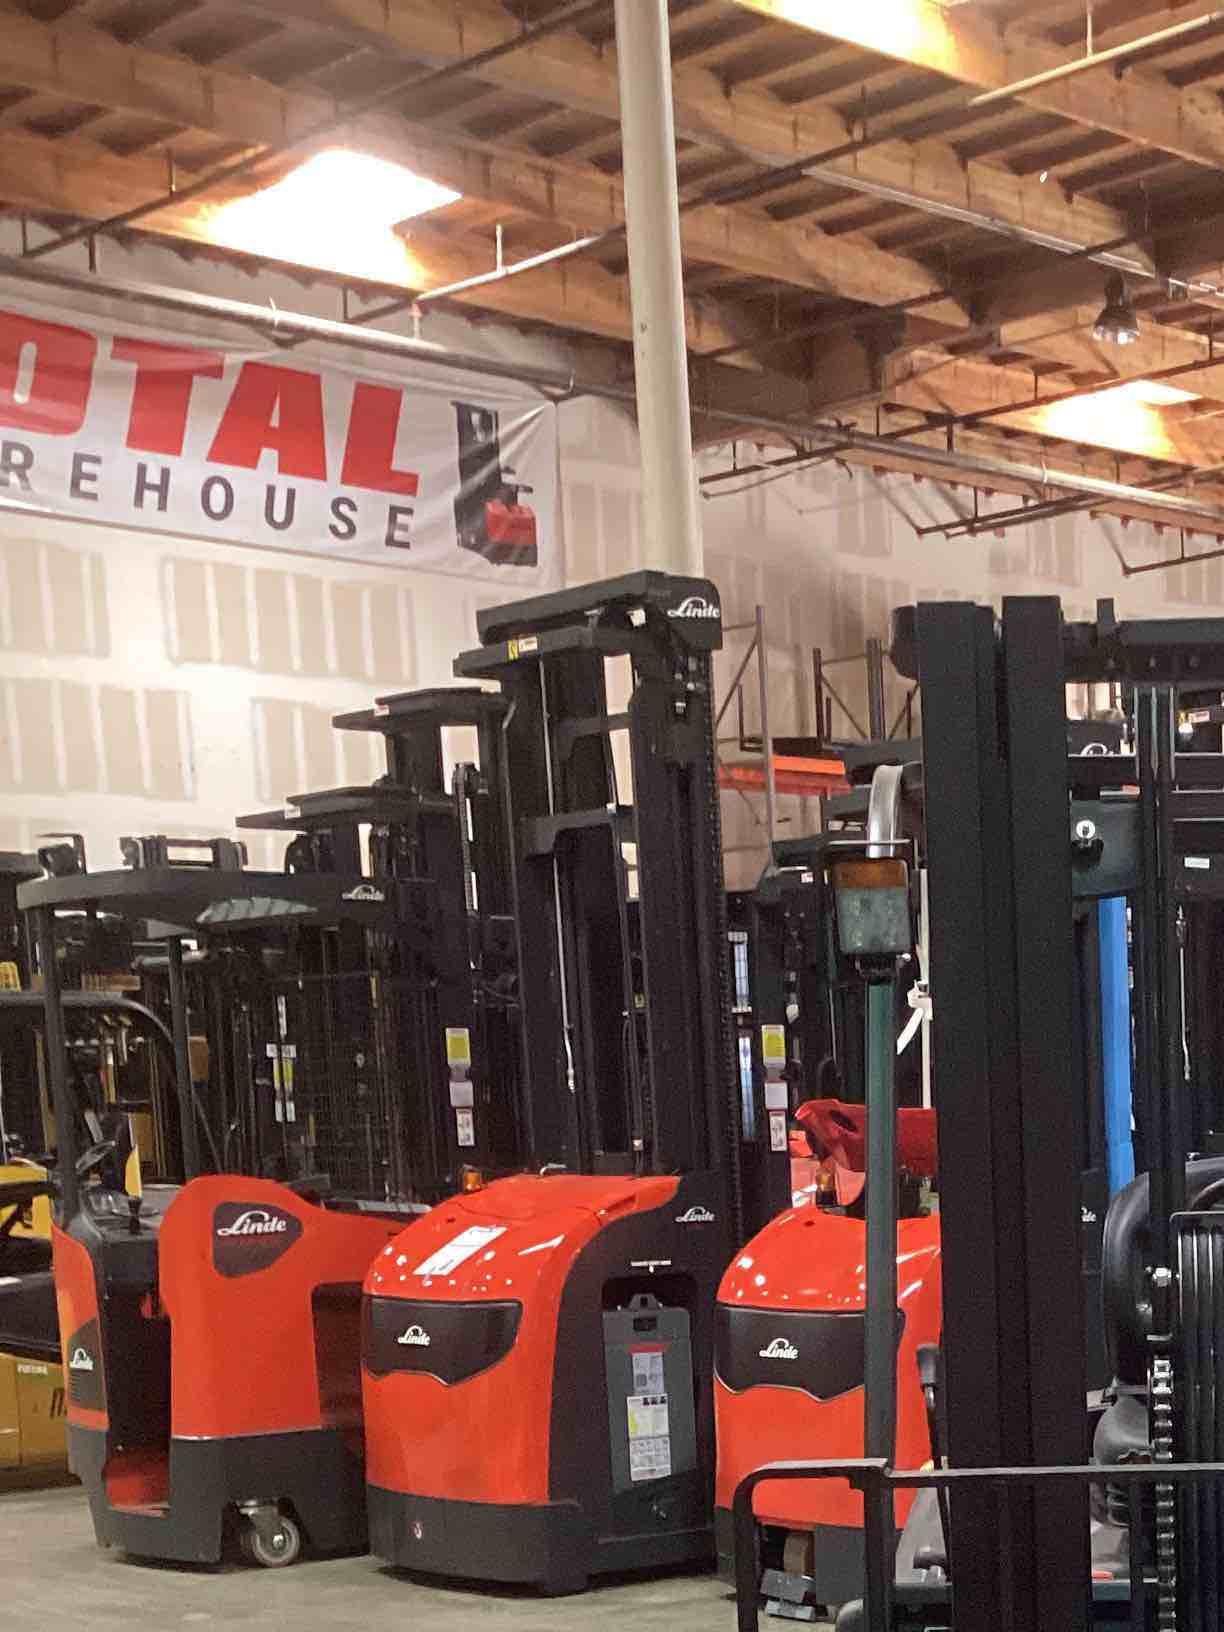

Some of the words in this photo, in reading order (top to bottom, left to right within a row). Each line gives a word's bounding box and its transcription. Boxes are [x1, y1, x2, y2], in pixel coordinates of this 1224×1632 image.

[667, 597, 720, 618] Linde
[217, 1210, 287, 1236] Linde
[397, 1325, 431, 1346] Linde
[759, 1338, 799, 1359] Linde
